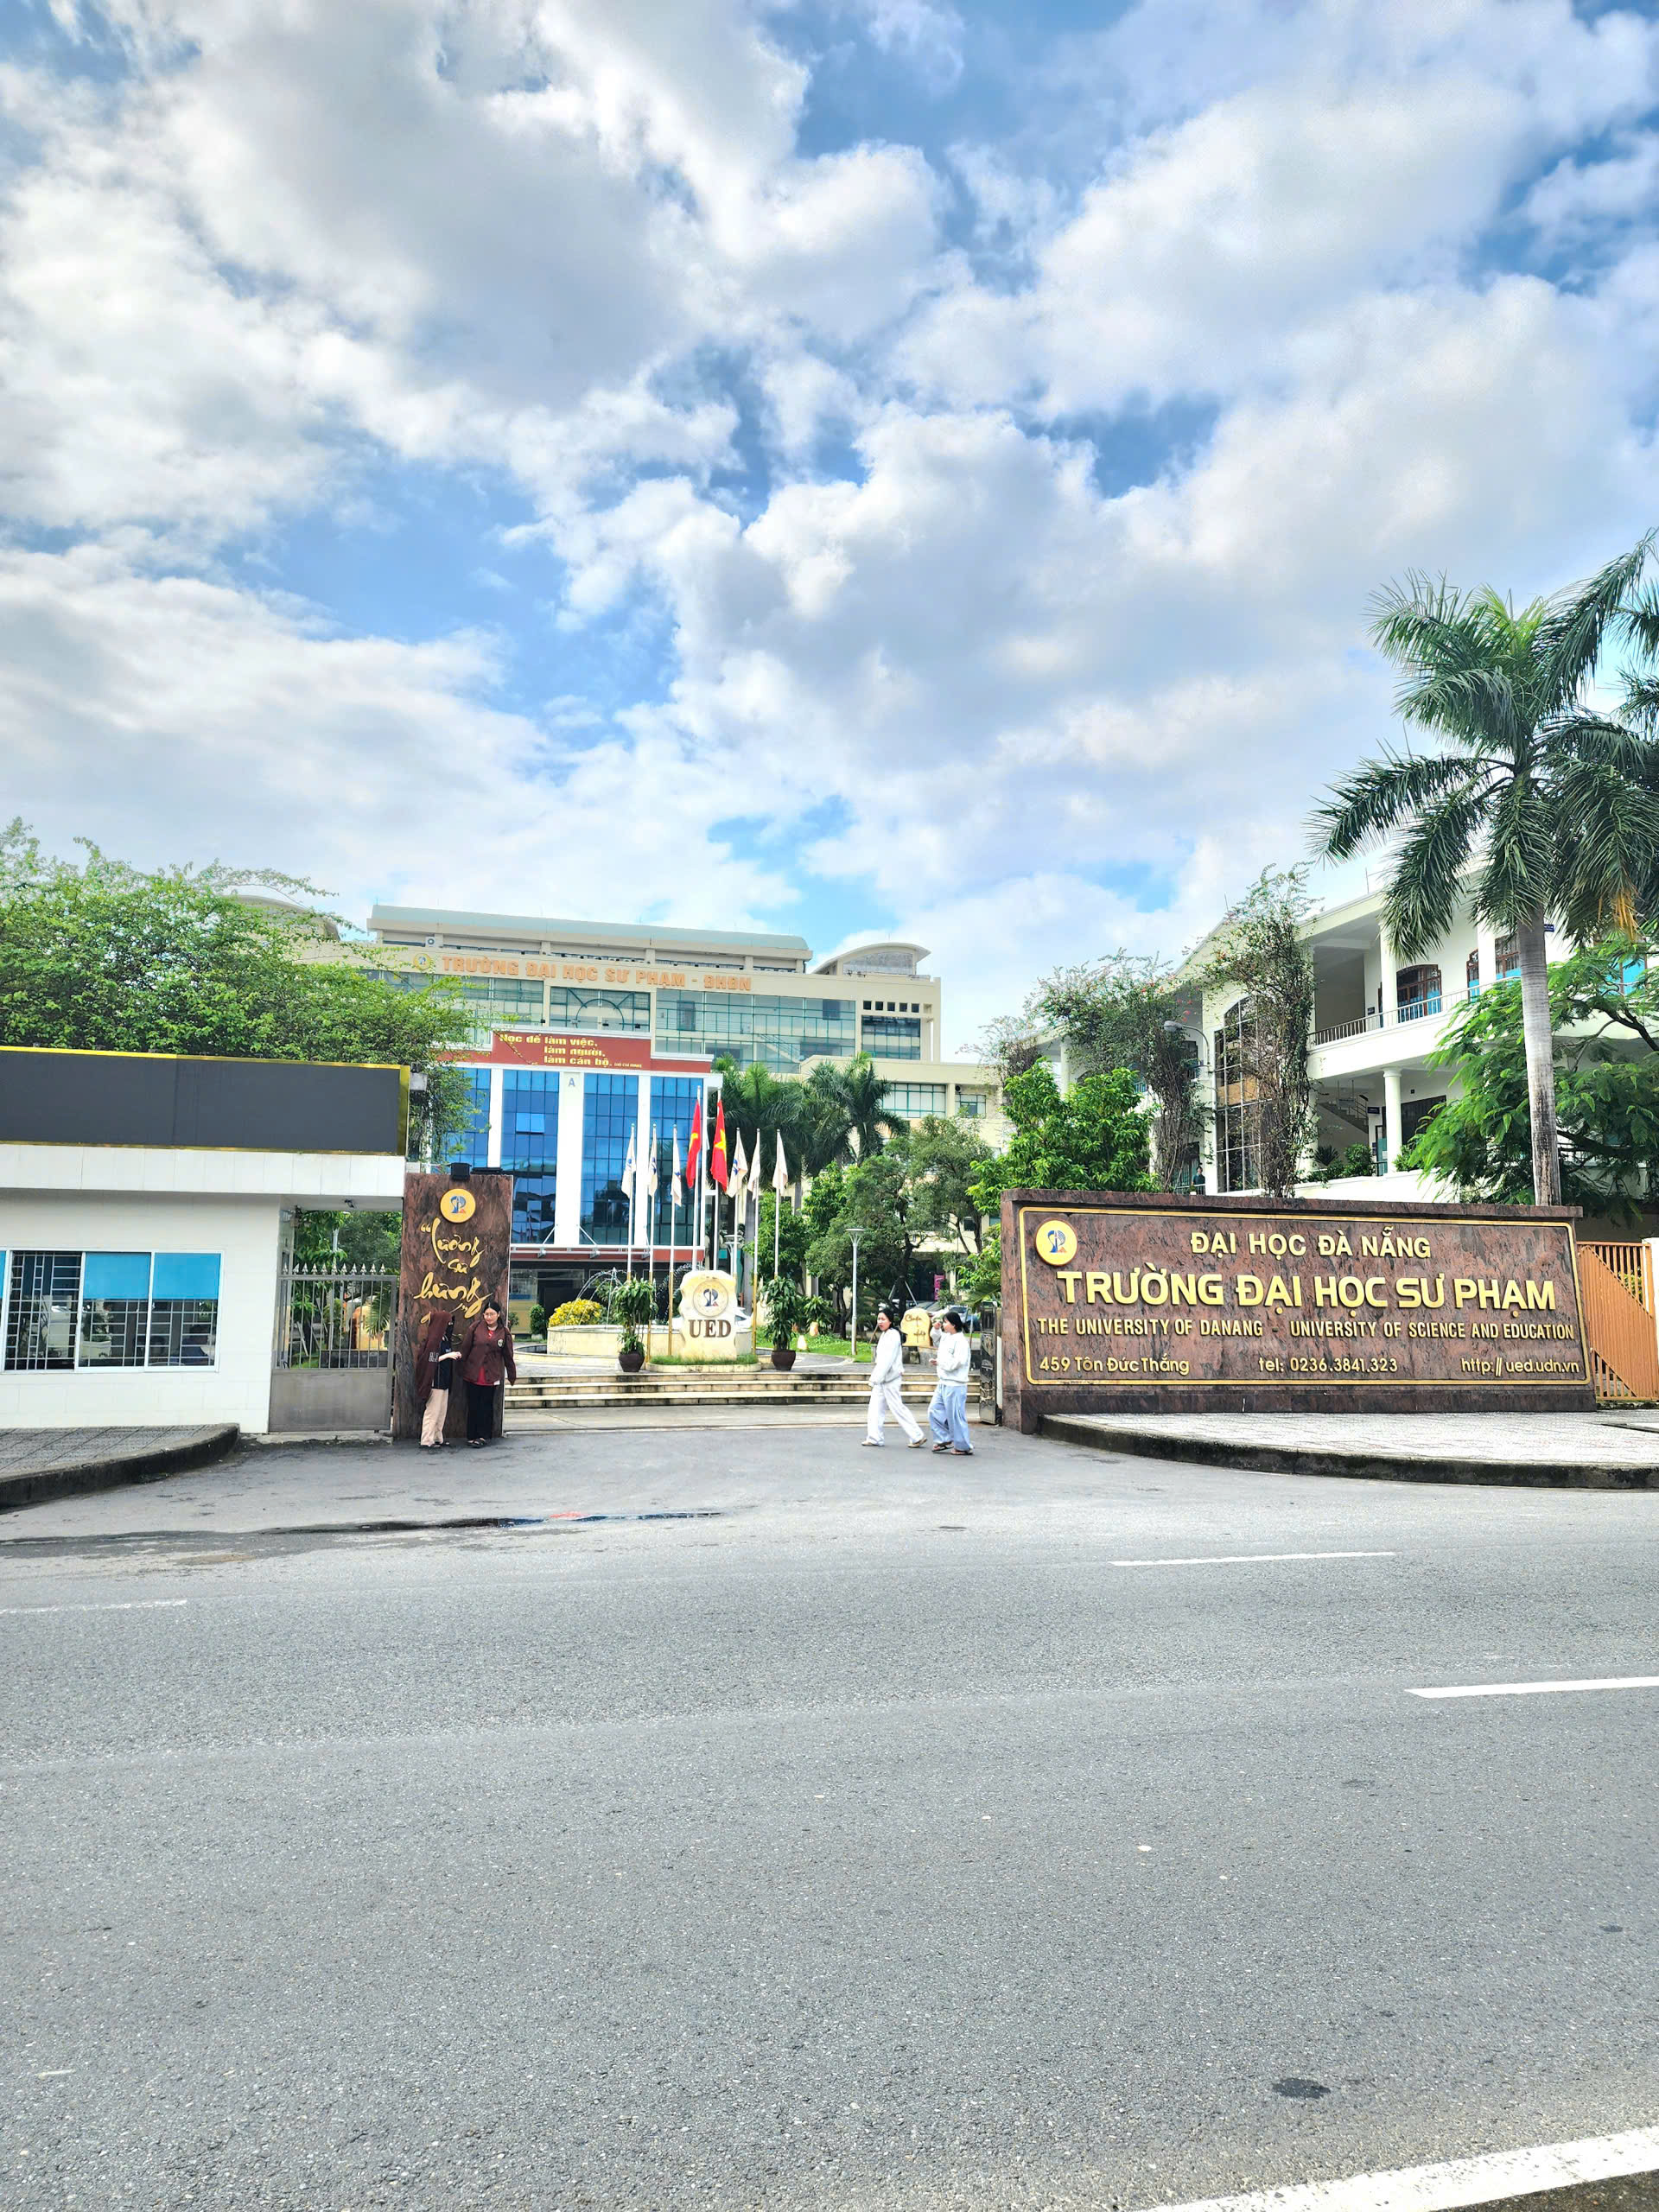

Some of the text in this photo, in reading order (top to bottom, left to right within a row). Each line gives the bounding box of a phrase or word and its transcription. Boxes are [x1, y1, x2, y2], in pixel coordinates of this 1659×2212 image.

[442, 955, 518, 976] TRƯỜNG
[526, 961, 556, 980] ĐẠI
[563, 964, 598, 982] HỌC
[605, 968, 629, 982] SƯ
[636, 969, 685, 988] PHẠM
[544, 1036, 567, 1046] làm
[544, 1046, 566, 1054] làm
[544, 1055, 566, 1064] làm
[1191, 1227, 1431, 1261] ĐẠI HỌC ĐÀ NẴNG
[1057, 1262, 1556, 1318] TRƯỜNG ĐẠI HỌC SƯ PHẠM
[688, 1319, 732, 1338] UED
[1038, 1318, 1069, 1335] THE
[1076, 1318, 1170, 1336] UNIVERSITY
[1175, 1319, 1192, 1336] OF
[1200, 1319, 1263, 1337] DANANG
[1290, 1320, 1376, 1338] UNIVERSITY
[1384, 1322, 1402, 1338] OF
[1409, 1322, 1466, 1338] SCIENCE
[1471, 1324, 1499, 1339] AND
[1503, 1324, 1575, 1339] EDUCATION
[1039, 1353, 1190, 1376] 459 Tôn Đức Thắng
[1259, 1357, 1398, 1373] tel: 0236.3841.323
